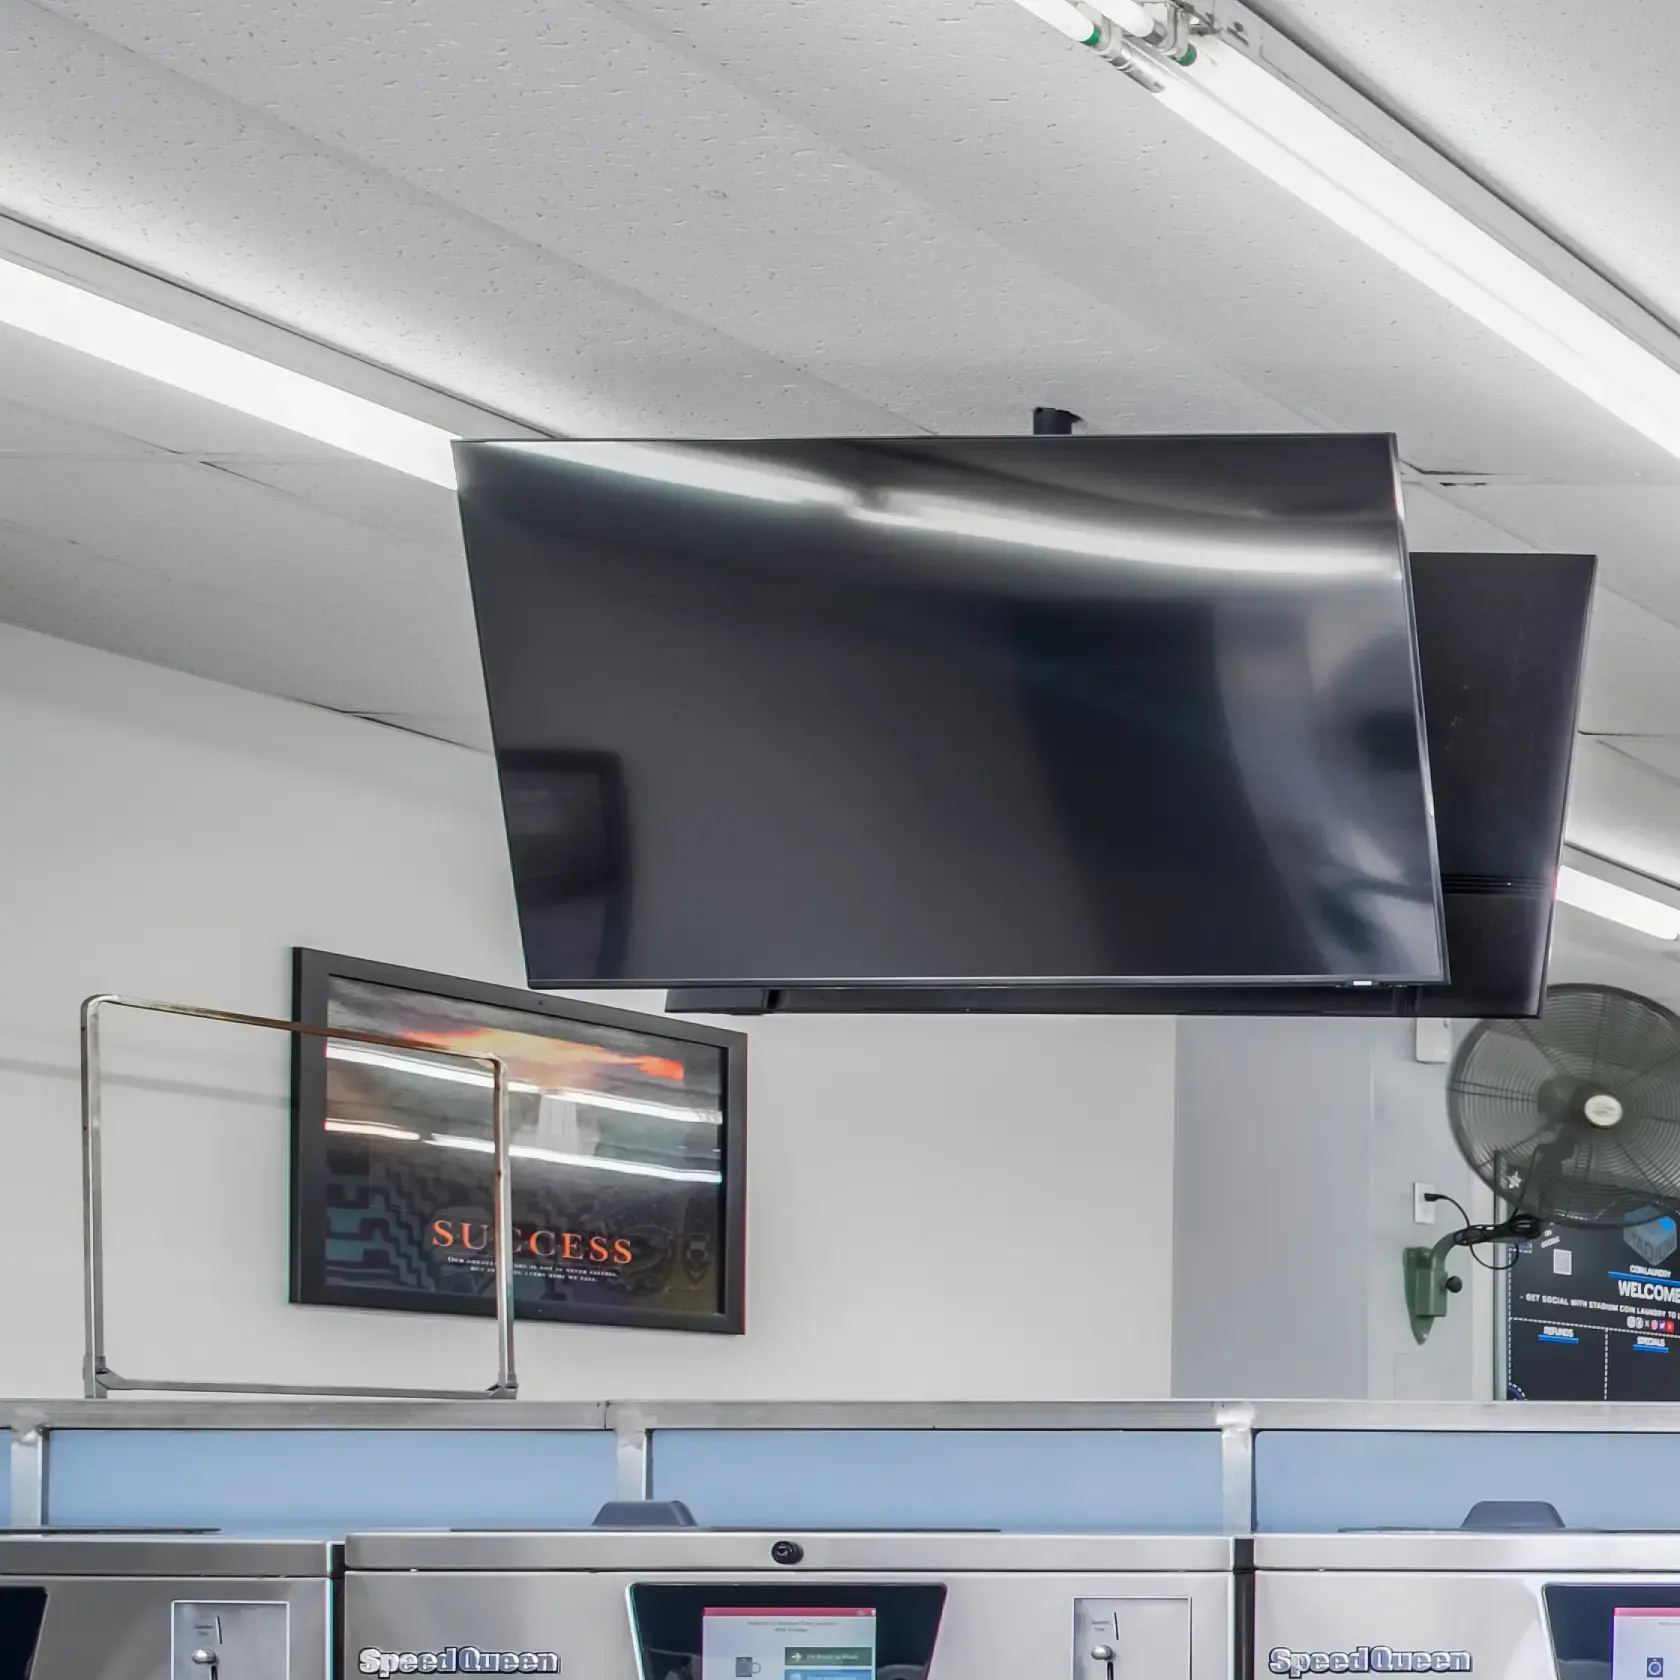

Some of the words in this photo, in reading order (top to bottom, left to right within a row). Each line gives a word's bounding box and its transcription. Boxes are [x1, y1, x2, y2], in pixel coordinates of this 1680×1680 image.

[1526, 1293, 1540, 1301] GET
[1542, 1295, 1569, 1305] SOCIAL
[1668, 1311, 1676, 1319] TO
[358, 1647, 457, 1680] Speed
[458, 1646, 558, 1674] Queen
[1268, 1646, 1369, 1679] Speed
[1370, 1645, 1471, 1673] Queen
